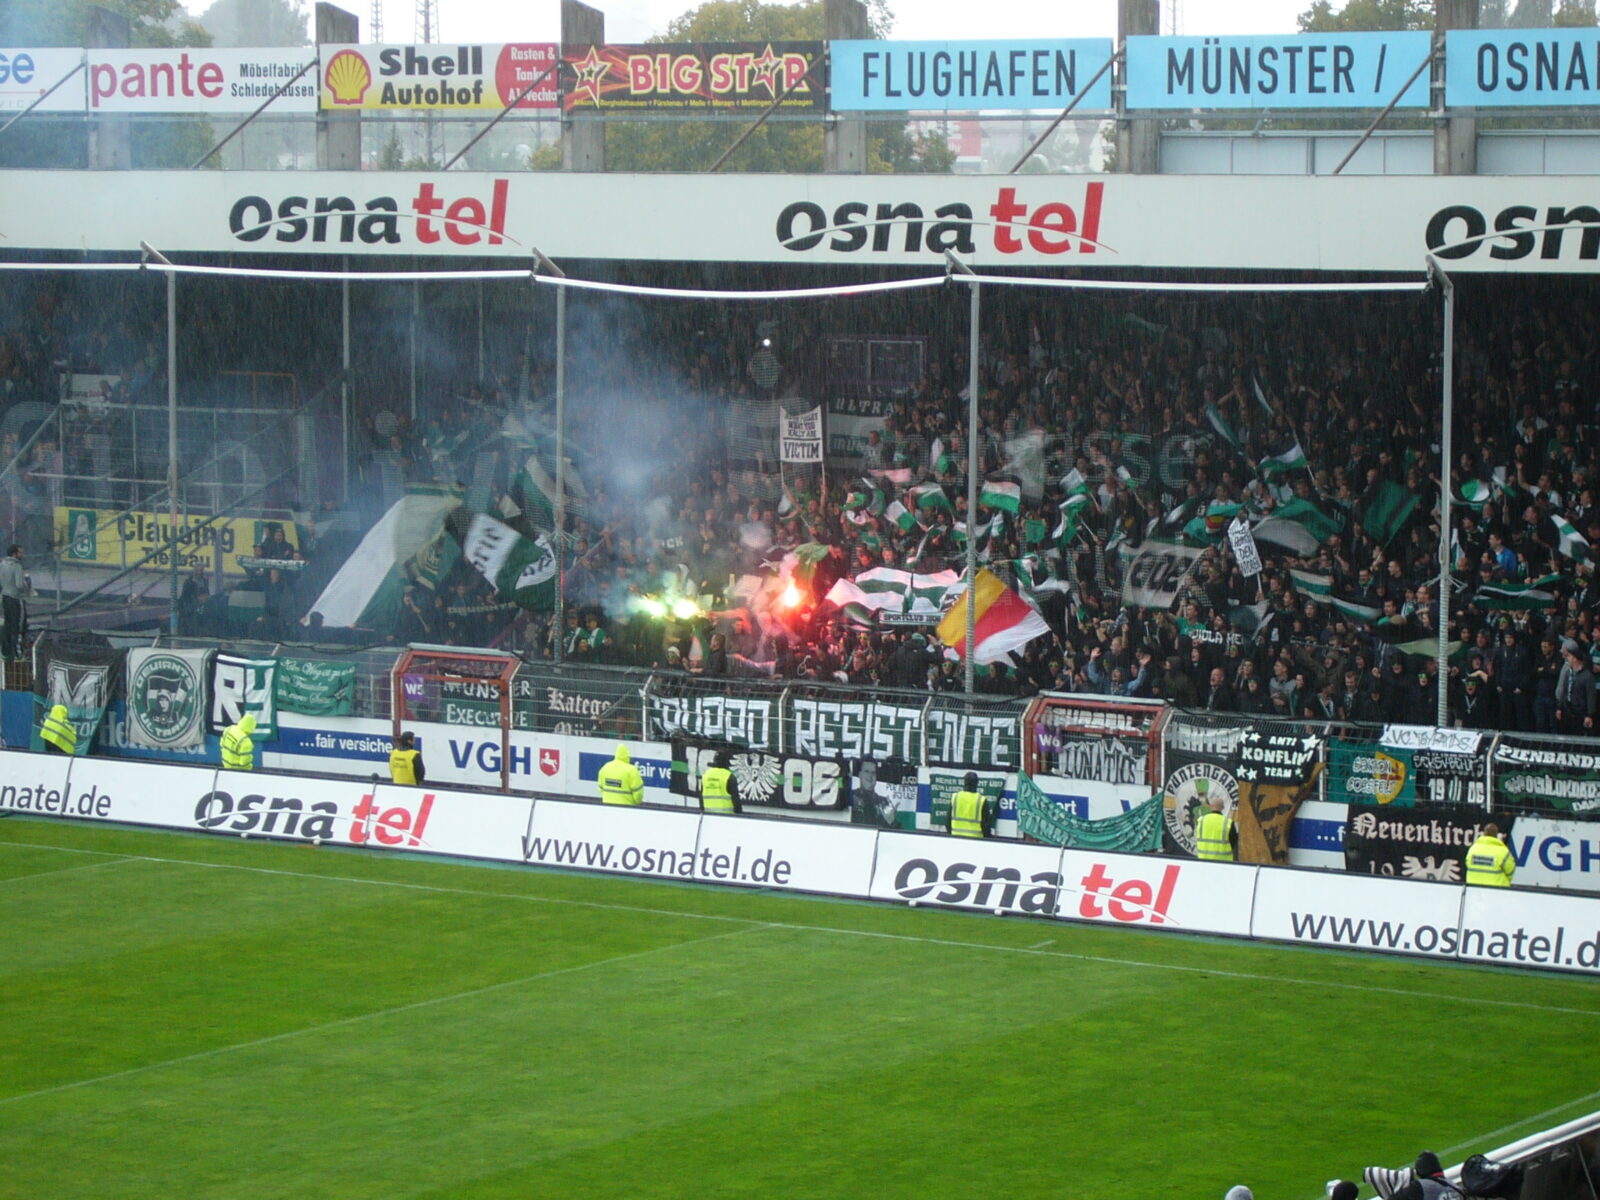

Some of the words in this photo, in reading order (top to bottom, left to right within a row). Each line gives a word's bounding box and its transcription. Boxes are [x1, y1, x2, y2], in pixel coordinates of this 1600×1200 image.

[240, 63, 306, 77] Möbelfabrik
[379, 46, 483, 76] Shell
[511, 47, 545, 61] Rasten
[547, 47, 556, 61] &
[1167, 38, 1355, 96] MÜNSTER
[1374, 44, 1387, 93] /
[1476, 42, 1600, 91] OSNA
[90, 54, 225, 107] pante
[231, 82, 314, 97] Schledehausen
[628, 53, 703, 95] BIG
[863, 49, 1076, 98] FLUGHAFEN
[380, 79, 484, 105] Autohof
[783, 441, 820, 459] VICTIM
[117, 513, 235, 554] Clausing
[142, 546, 211, 568] Tiebau
[446, 703, 528, 727] EXECUTE
[793, 698, 1016, 767] RESISTENTE
[299, 730, 337, 750] ...fair
[338, 733, 393, 754] versiche
[448, 739, 531, 775] VGH
[1268, 736, 1298, 746] ANTI
[783, 758, 841, 806] 06
[1264, 767, 1292, 778] TEAM
[1428, 777, 1446, 801] 19
[1165, 809, 1197, 852] MILITAN
[1351, 811, 1507, 847] Neuenkirchr
[521, 835, 792, 885] www.osnatel.de
[1509, 835, 1600, 873] VGH
